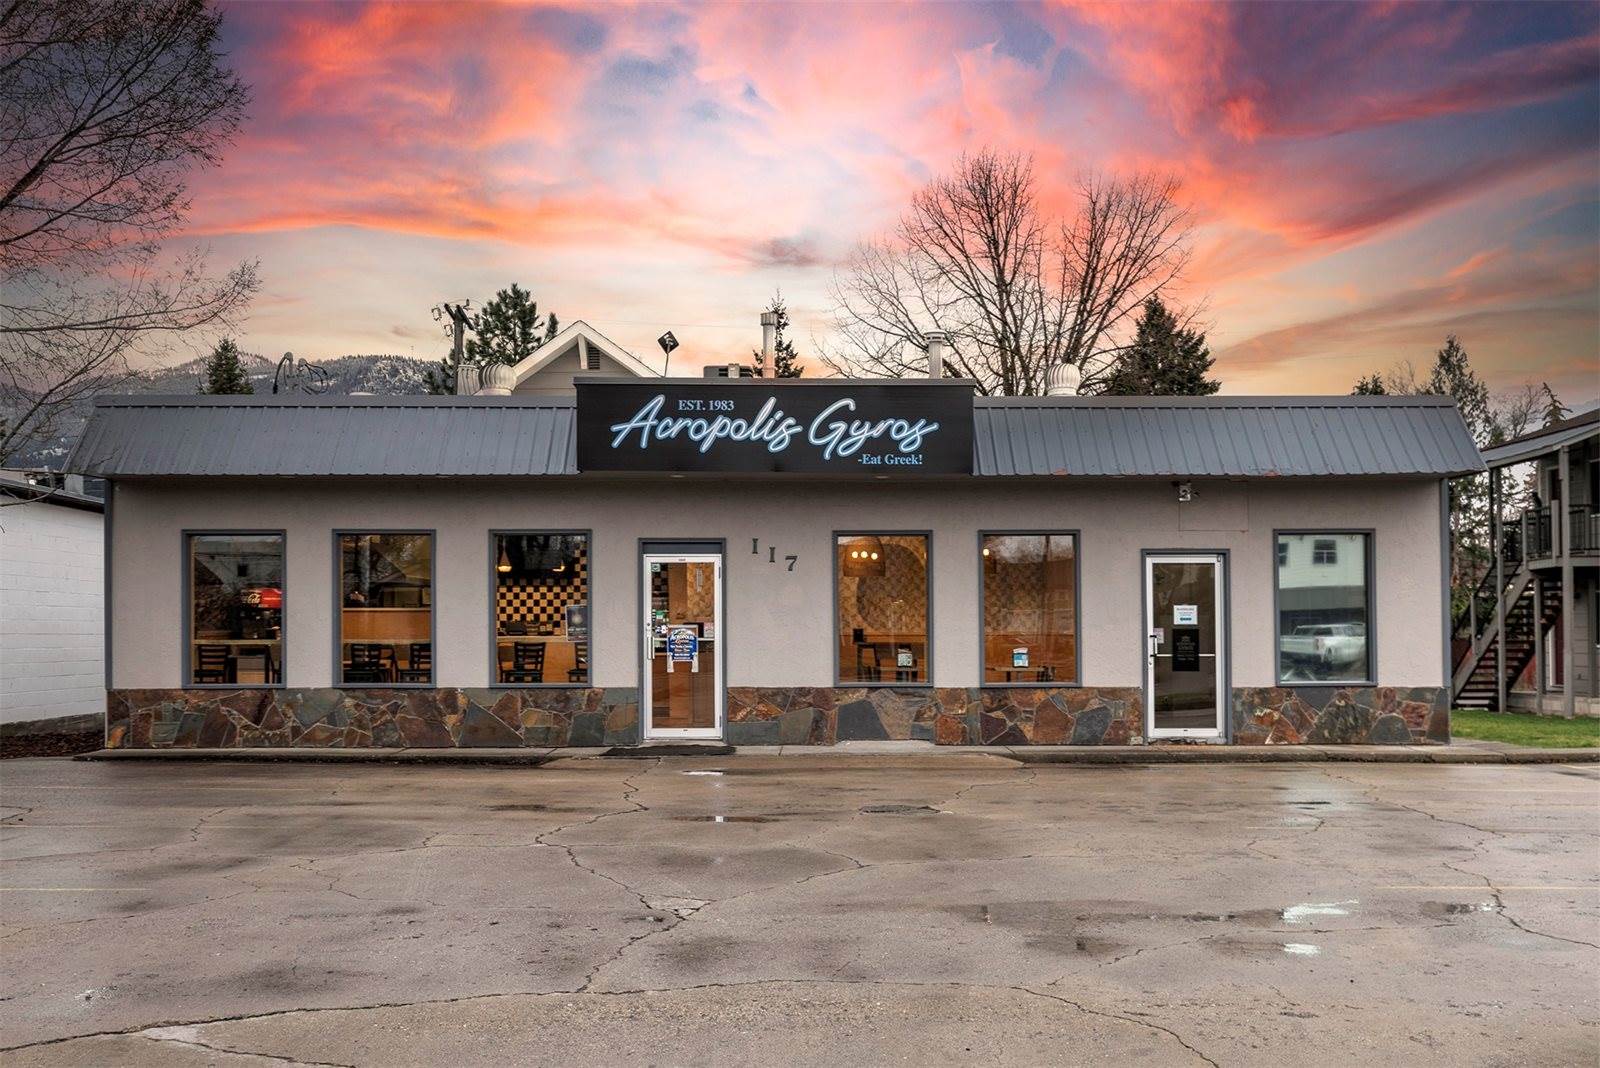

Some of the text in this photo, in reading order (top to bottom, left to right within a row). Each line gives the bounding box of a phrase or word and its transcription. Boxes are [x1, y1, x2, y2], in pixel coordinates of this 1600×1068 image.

[678, 399, 735, 411] EST. 1983
[610, 394, 940, 459] Acropolis Gyros
[857, 453, 924, 465] -Eat Greek!
[752, 538, 798, 572] 117
